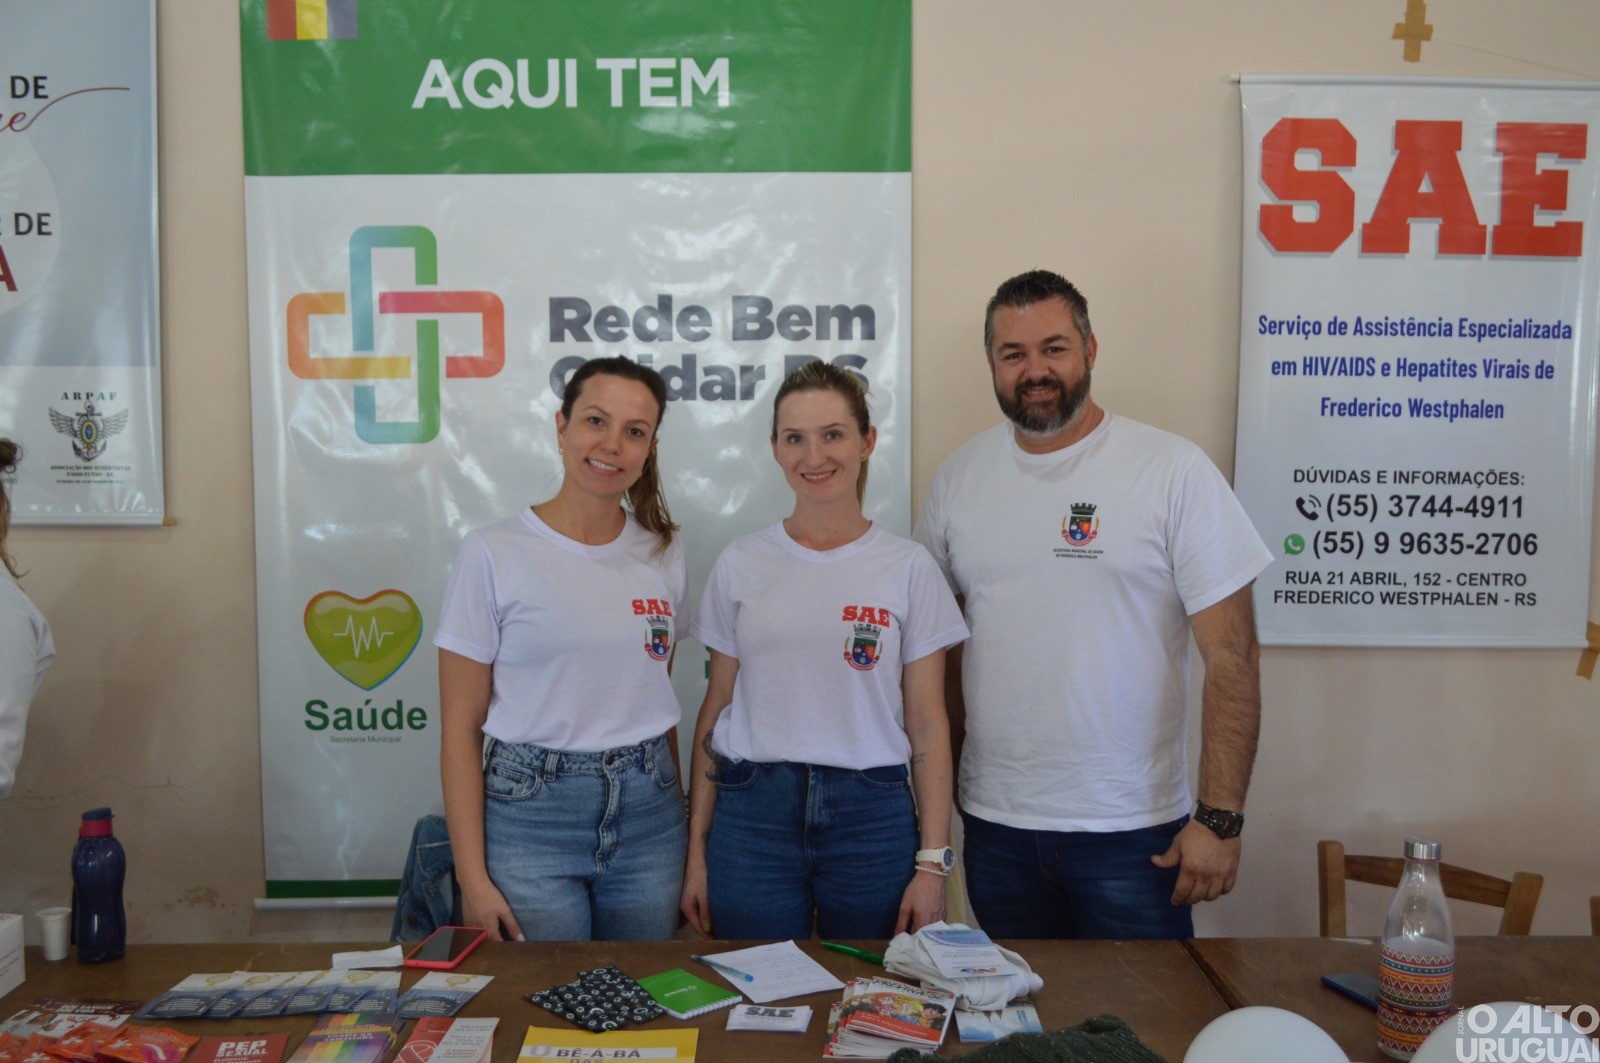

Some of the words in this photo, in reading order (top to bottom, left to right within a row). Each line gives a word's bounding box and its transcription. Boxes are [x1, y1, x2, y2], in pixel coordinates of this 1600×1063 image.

[10, 75, 49, 99] DE
[412, 58, 578, 109] AQUI
[597, 57, 735, 108] TEM
[1257, 117, 1588, 259] SAE
[14, 212, 53, 236] DE
[549, 295, 711, 342] Rede
[732, 296, 876, 341] Bem
[1258, 315, 1322, 341] Serviço
[1327, 316, 1347, 336] de
[1352, 317, 1454, 338] Assistência
[1458, 318, 1573, 343] Especializada
[1271, 361, 1297, 376] em
[1302, 357, 1376, 377] HIV/AIDS
[1380, 362, 1391, 377] e
[1396, 358, 1478, 383] Hepatites
[1482, 359, 1530, 380] Virais
[1534, 360, 1555, 380] de
[1321, 396, 1402, 418] Frederico
[1407, 398, 1505, 424] Westphalen
[1293, 466, 1371, 484] DÚVIDAS
[1376, 470, 1388, 484] E
[1393, 469, 1525, 489] INFORMAÇÕES:
[1326, 494, 1378, 523] (55)
[1388, 495, 1523, 519] 3744-4911
[1313, 531, 1364, 560] (55)
[1374, 532, 1390, 555] 9
[1399, 532, 1538, 556] 9635-2706
[1285, 571, 1323, 585] RUA
[1327, 572, 1344, 585] 21
[1349, 572, 1407, 588] ABRIL,
[1413, 573, 1441, 586] 152
[1456, 573, 1527, 587] CENTRO
[631, 598, 673, 618] SAE
[1274, 590, 1375, 605] FREDERICO
[1380, 591, 1498, 606] WESTPHALEN
[1514, 593, 1537, 607] RS
[841, 605, 890, 628] SAE
[304, 699, 428, 731] Saúde
[329, 735, 366, 744] Secretaria
[367, 735, 402, 745] Municipal
[744, 1006, 796, 1018] SAE
[215, 1048, 268, 1057] SEXUAL
[218, 1039, 268, 1052] PEP
